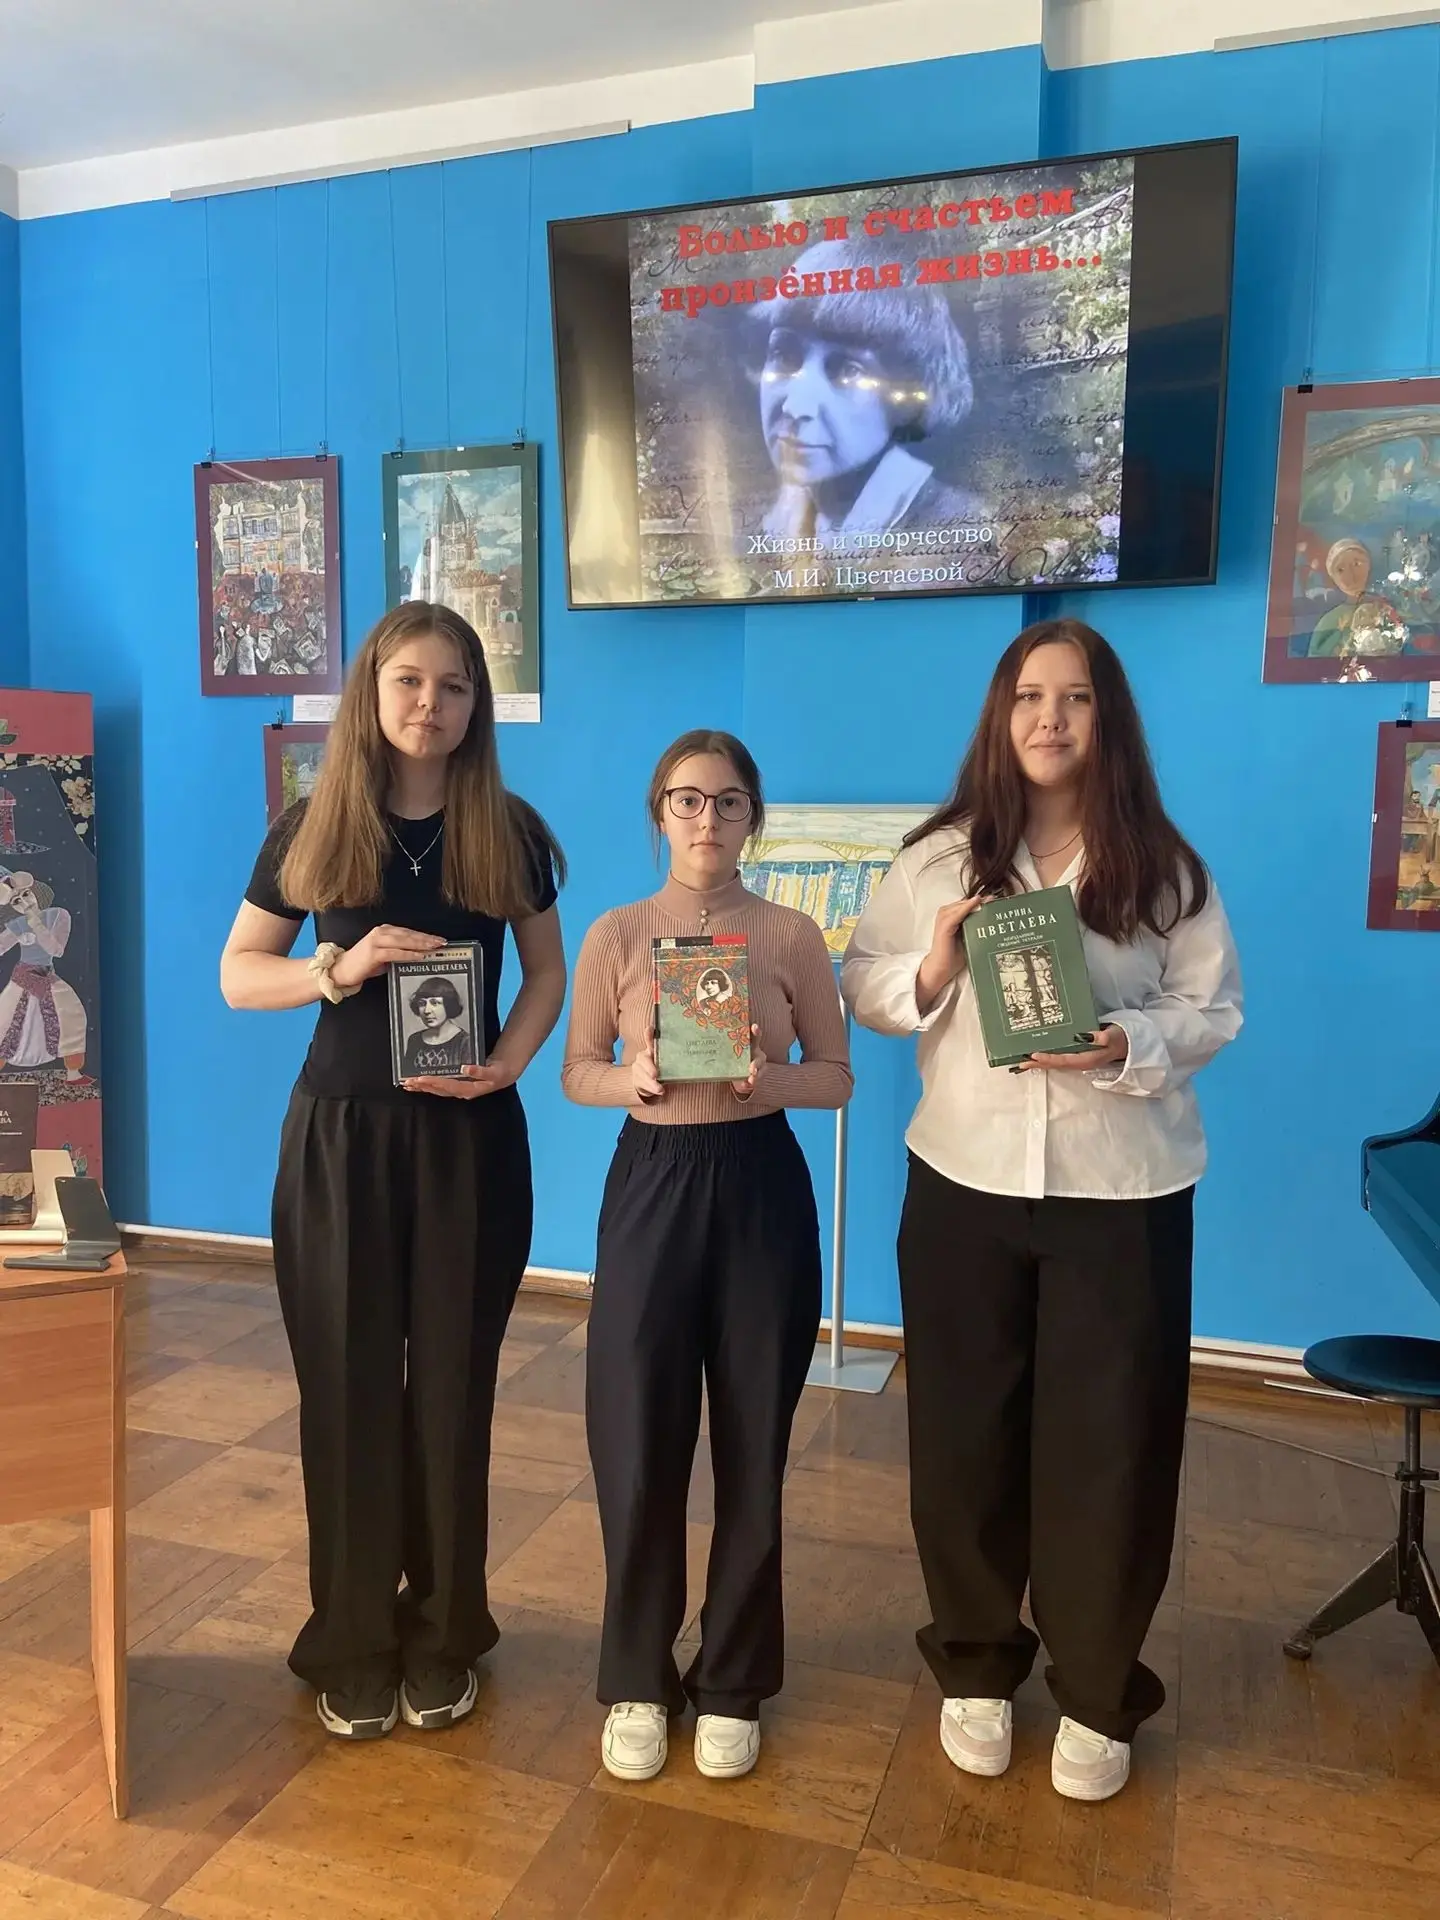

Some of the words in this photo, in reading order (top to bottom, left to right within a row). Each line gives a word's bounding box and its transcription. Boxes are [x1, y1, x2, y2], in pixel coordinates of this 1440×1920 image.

[677, 219, 809, 260] Болью
[822, 215, 850, 242] и
[862, 187, 1078, 238] счастьем
[659, 261, 904, 319] пронзённая
[915, 245, 1103, 286] жизнь...
[746, 533, 825, 555] Жизнь
[831, 535, 847, 550] и
[853, 526, 993, 553] творчество
[774, 567, 828, 589] М.И.
[835, 560, 966, 588] Цветаевой
[976, 912, 1057, 939] ЦВЕТАЕВА
[994, 906, 1033, 921] МАРИНА
[398, 965, 431, 973] МАРИНА
[431, 963, 469, 973] ЦВЕТАЕВА
